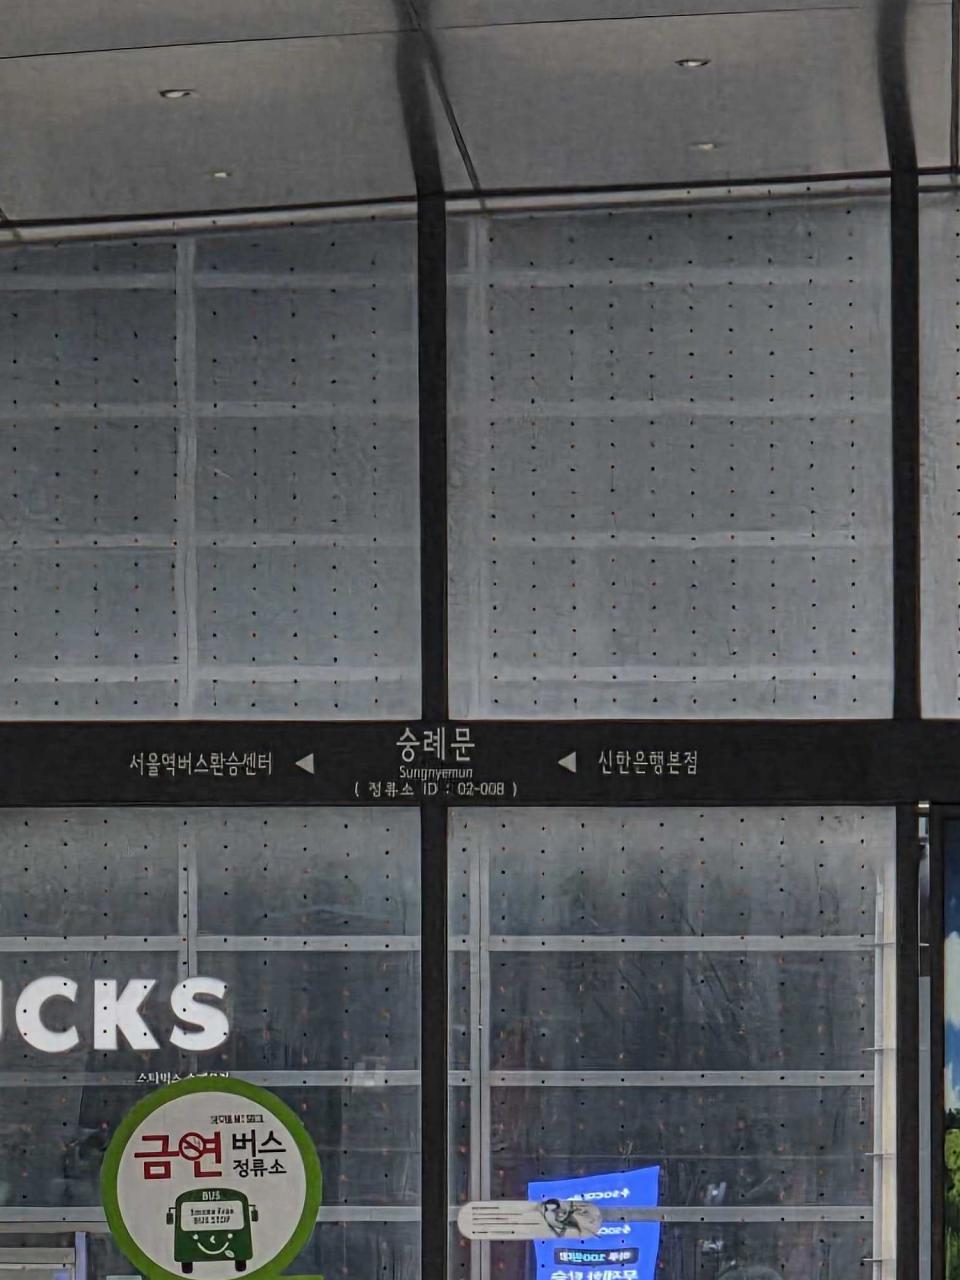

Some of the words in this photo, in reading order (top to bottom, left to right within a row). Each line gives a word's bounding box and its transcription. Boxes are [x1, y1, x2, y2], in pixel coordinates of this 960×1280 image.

[396, 727, 475, 762] 숭례문
[130, 752, 273, 776] 서울역버스환승센터
[399, 765, 473, 780] Sungnyemun
[598, 750, 698, 775] 신한은행본점
[368, 781, 414, 797] 정류소
[232, 1129, 287, 1157] 버스
[134, 1131, 223, 1180] 금연
[233, 1159, 287, 1178] 정류소
[202, 1190, 221, 1201] BUS
